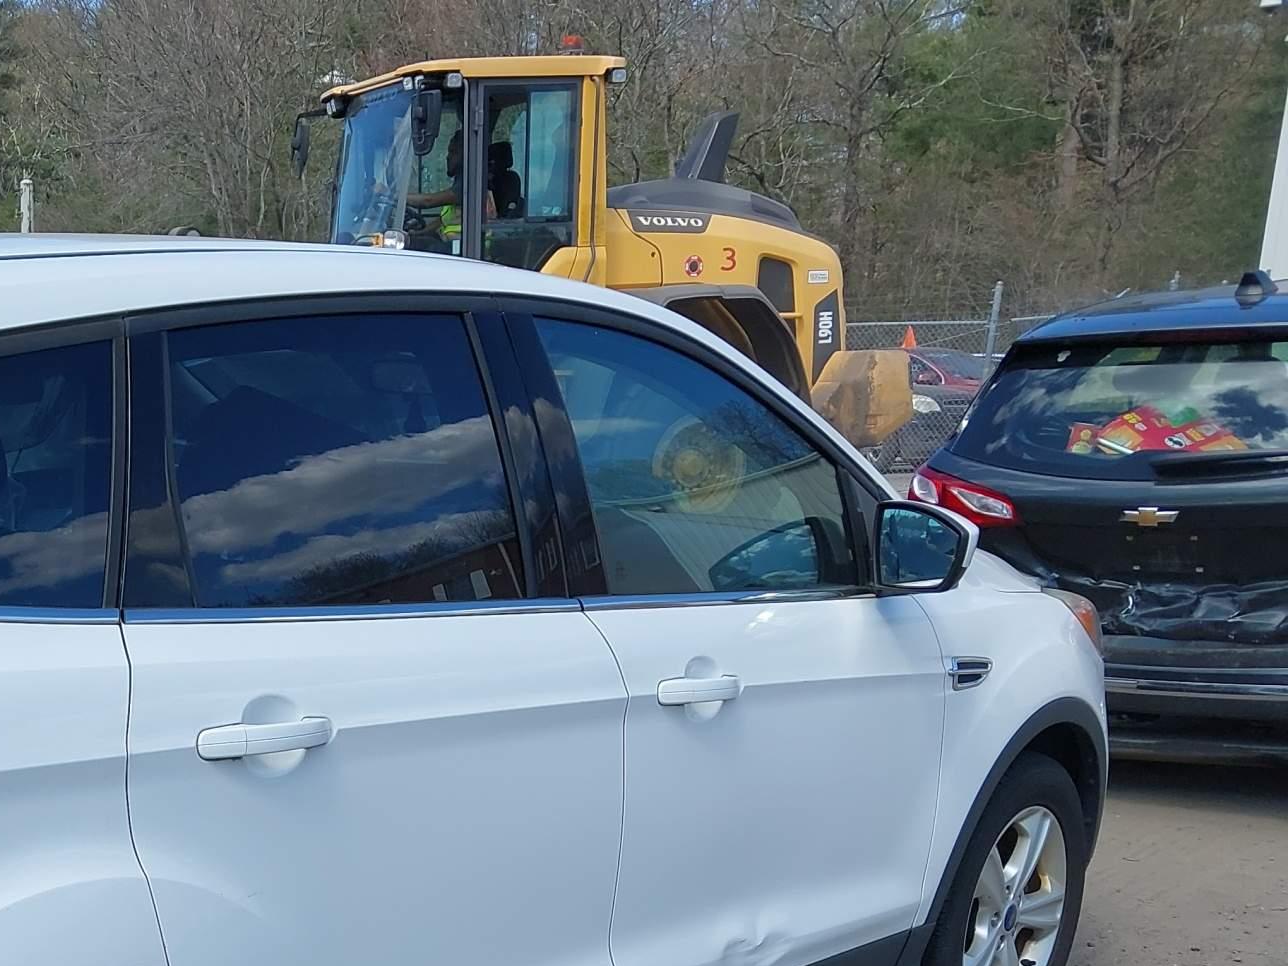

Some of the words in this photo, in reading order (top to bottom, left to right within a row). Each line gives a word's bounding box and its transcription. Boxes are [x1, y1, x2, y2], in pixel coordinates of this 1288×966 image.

[636, 215, 703, 228] VOLVO
[720, 247, 737, 271] 3
[818, 311, 833, 344] L90H
